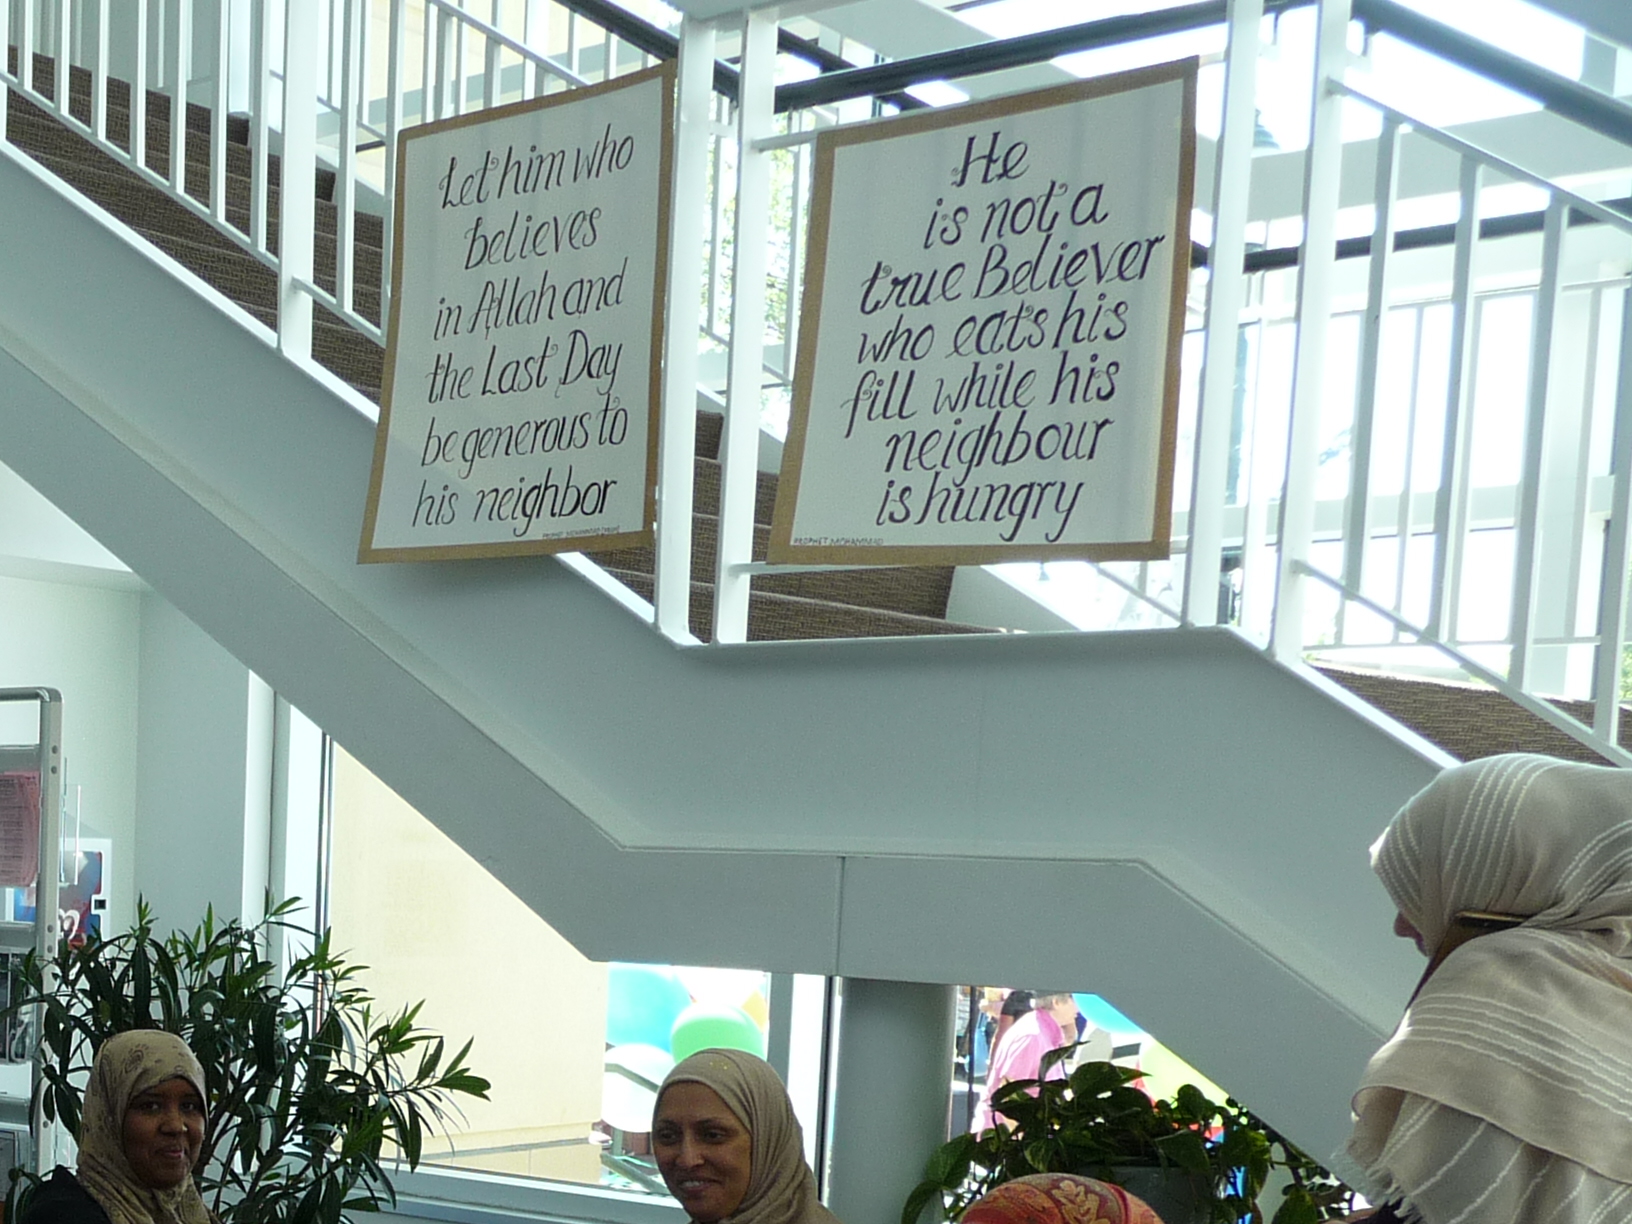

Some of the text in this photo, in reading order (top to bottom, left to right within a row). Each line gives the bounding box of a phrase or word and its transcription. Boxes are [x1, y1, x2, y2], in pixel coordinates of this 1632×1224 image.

[439, 123, 634, 209] Let him who
[951, 131, 1029, 187] He
[464, 206, 602, 270] believes
[923, 179, 1109, 249] is not a
[433, 256, 629, 341] in Allah and
[860, 233, 1166, 315] true Believer
[857, 290, 1129, 364] who eats his
[425, 329, 623, 404] the Last Day
[840, 350, 1120, 439] fill while his
[421, 392, 628, 480] be generous to
[884, 409, 1115, 488] neighbour
[412, 464, 617, 537] his neighbor
[875, 471, 1085, 543] is hungry
